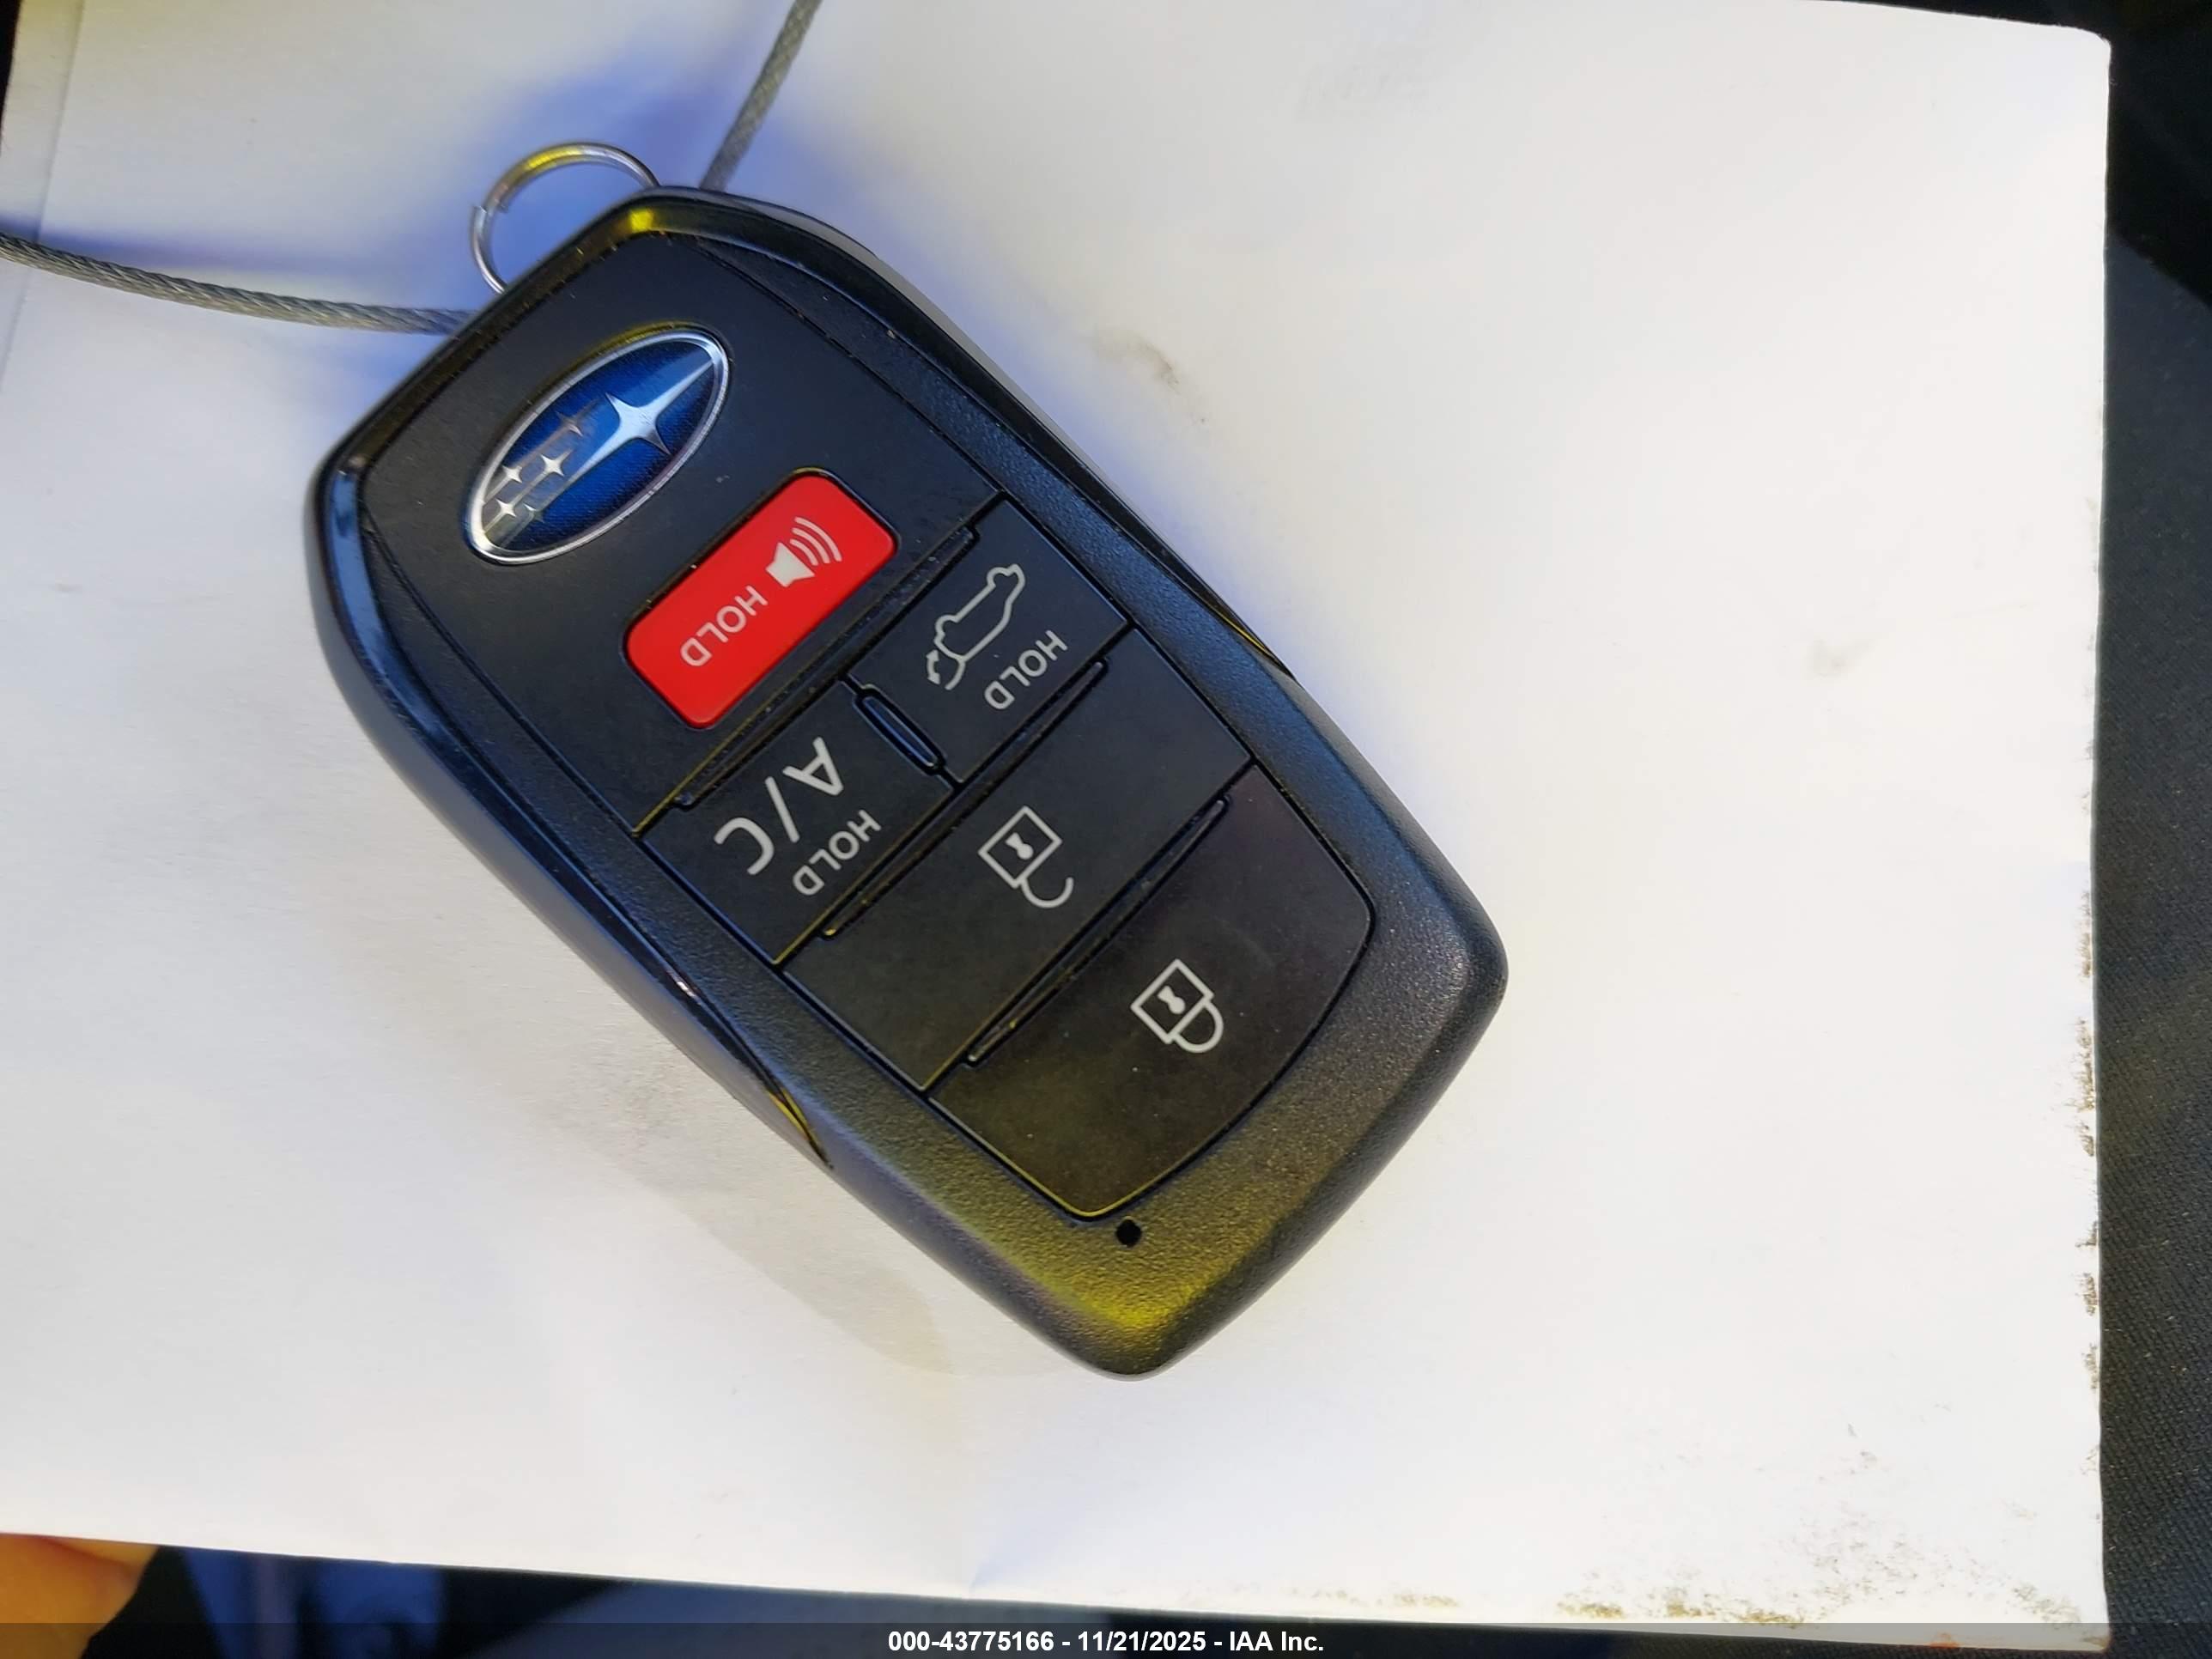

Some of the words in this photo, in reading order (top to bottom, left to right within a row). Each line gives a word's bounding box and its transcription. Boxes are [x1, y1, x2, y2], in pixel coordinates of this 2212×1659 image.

[681, 586, 768, 667] HOLD
[983, 629, 1068, 710] HOLD
[714, 737, 844, 875] A/C
[791, 810, 882, 896] HOLD
